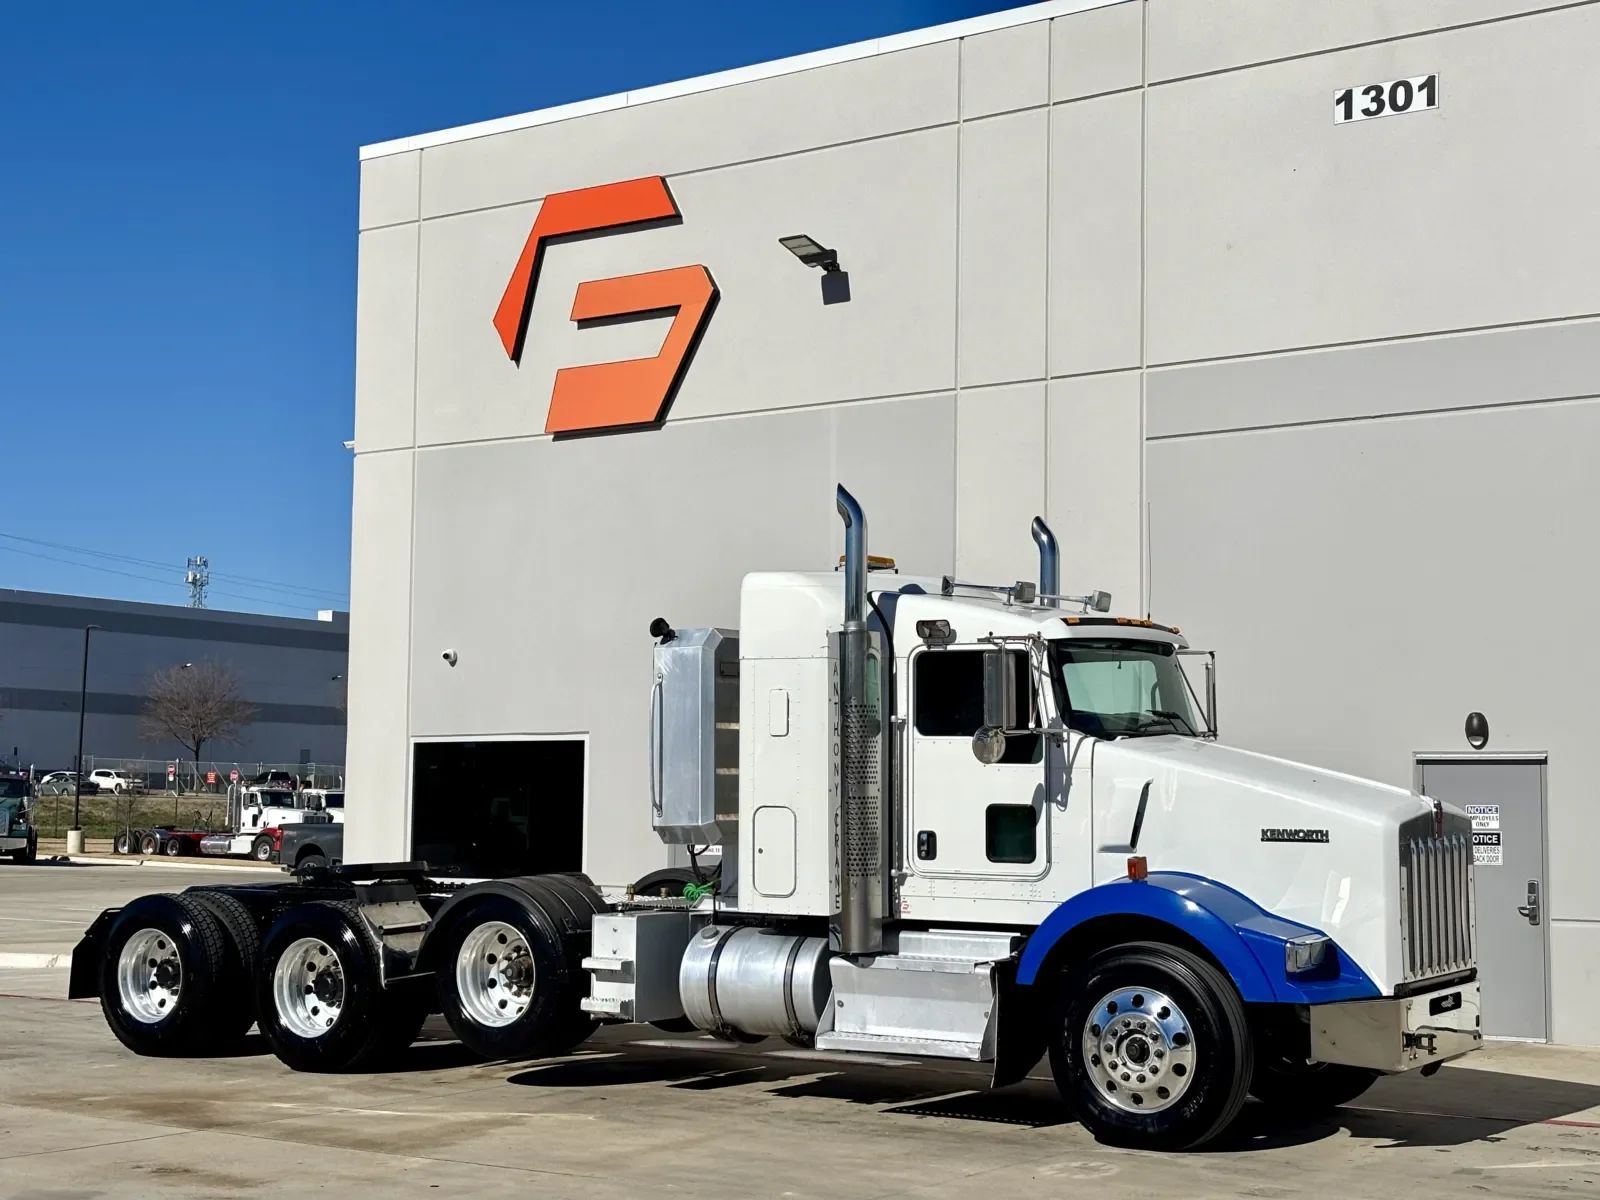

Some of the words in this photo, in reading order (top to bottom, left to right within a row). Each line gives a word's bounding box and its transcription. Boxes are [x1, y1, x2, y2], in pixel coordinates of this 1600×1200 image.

[1335, 74, 1436, 121] 1301
[1467, 806, 1498, 814] NOTICE
[1261, 828, 1329, 842] KENWORTH
[1472, 835, 1498, 843] OTICE
[1486, 855, 1500, 863] DOOR
